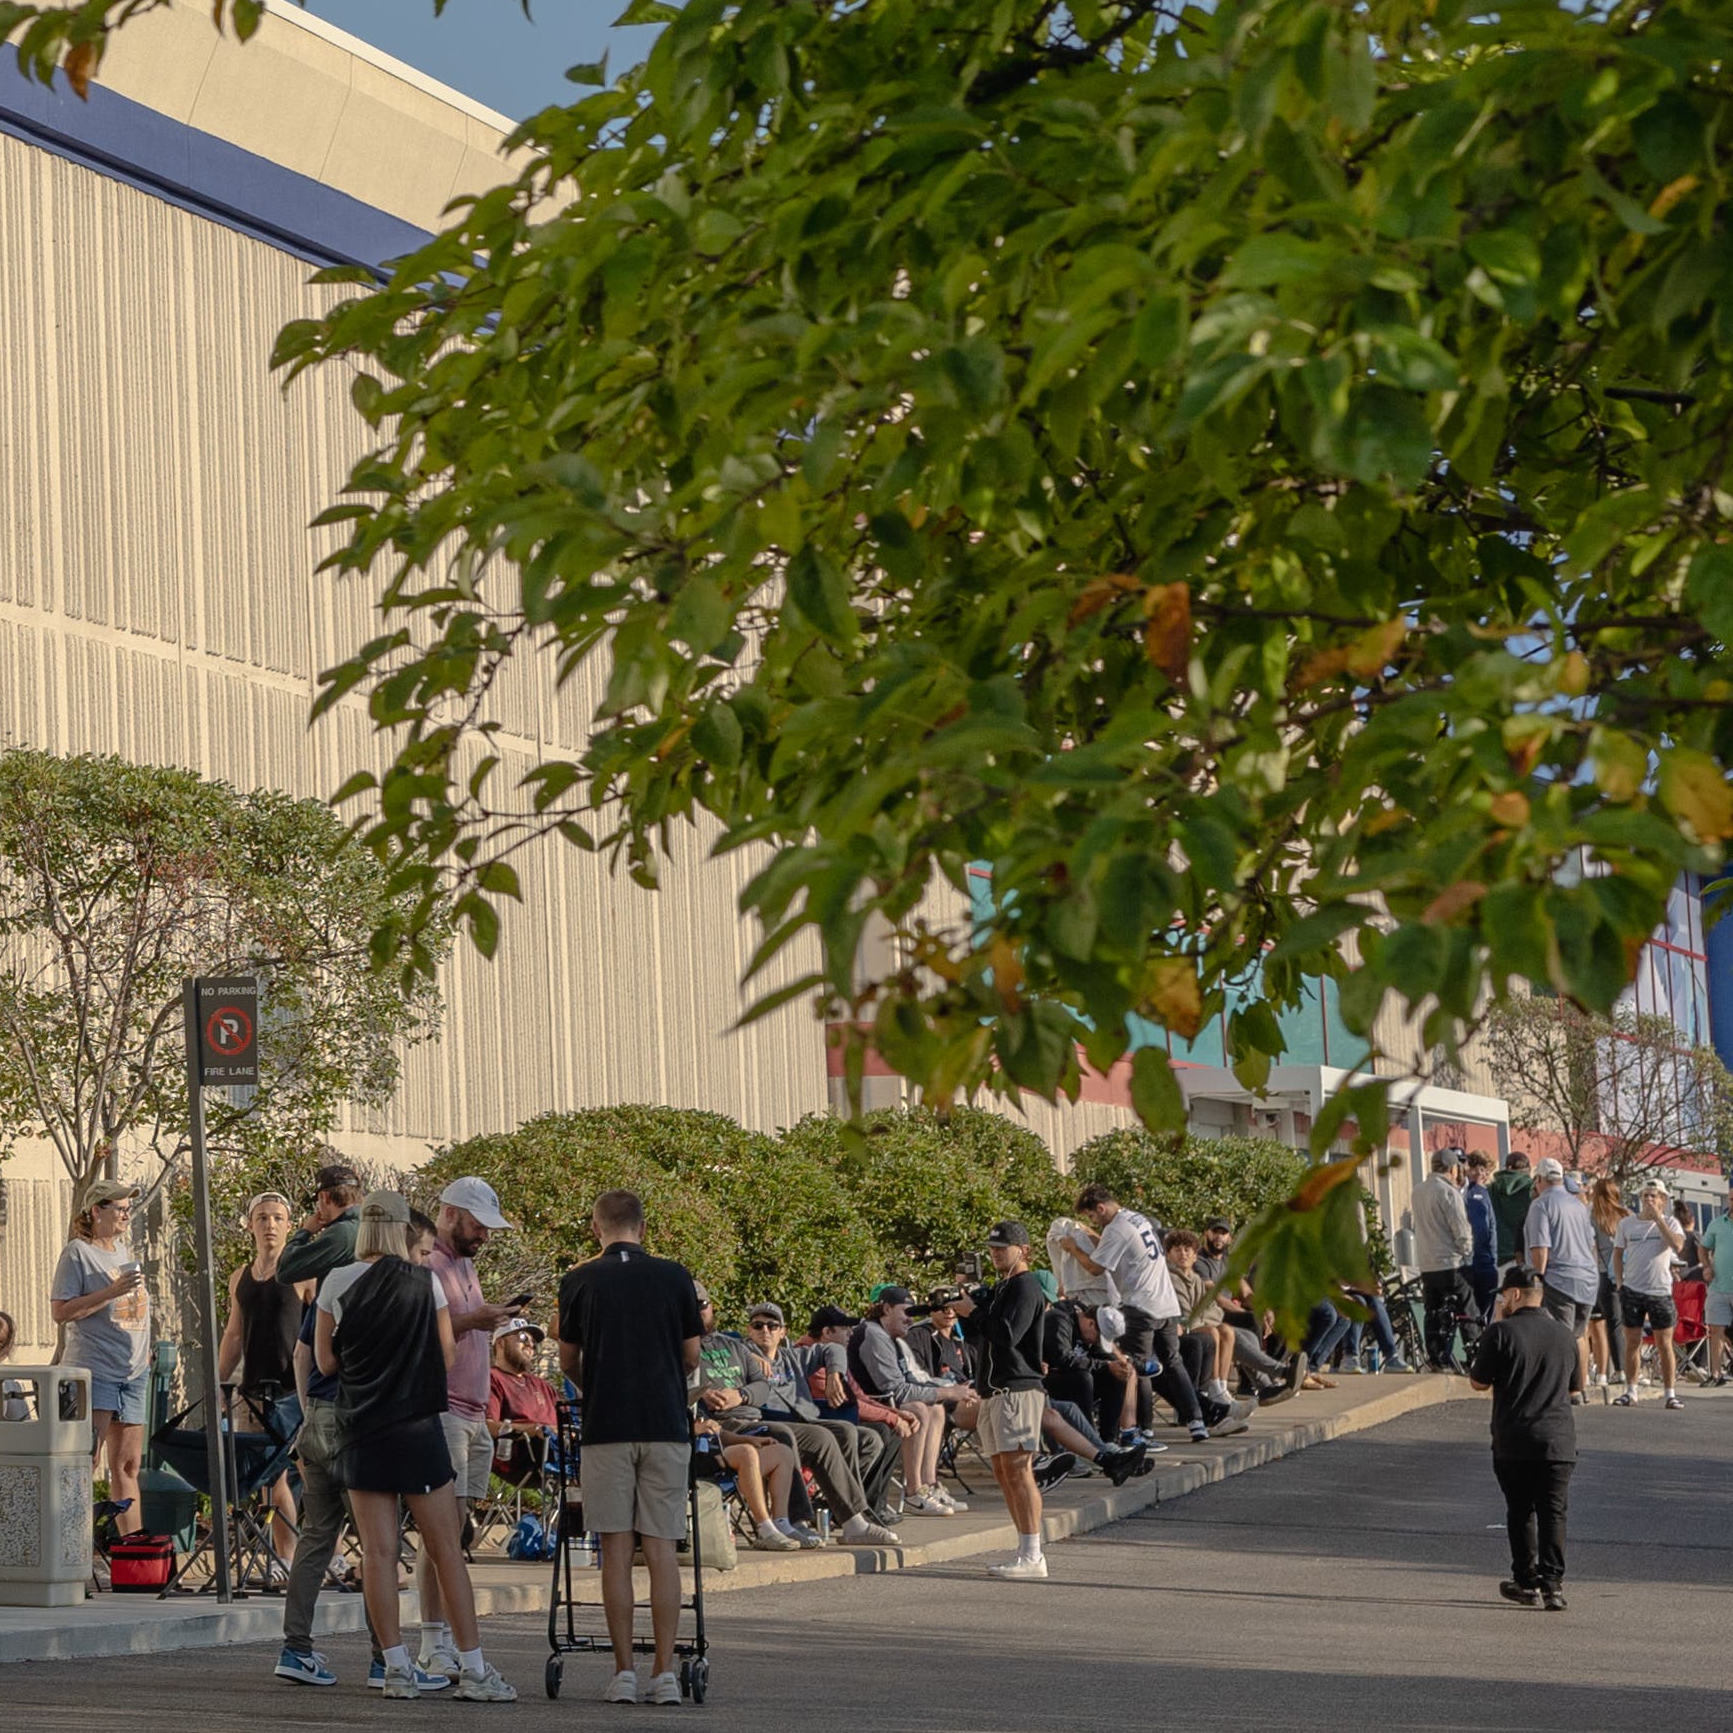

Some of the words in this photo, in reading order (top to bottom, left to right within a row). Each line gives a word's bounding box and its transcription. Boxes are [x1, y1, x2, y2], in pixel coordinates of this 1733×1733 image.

[201, 987, 215, 996] NO
[217, 986, 257, 996] PARKING
[204, 1067, 226, 1076] FIRE
[229, 1067, 254, 1076] LANE
